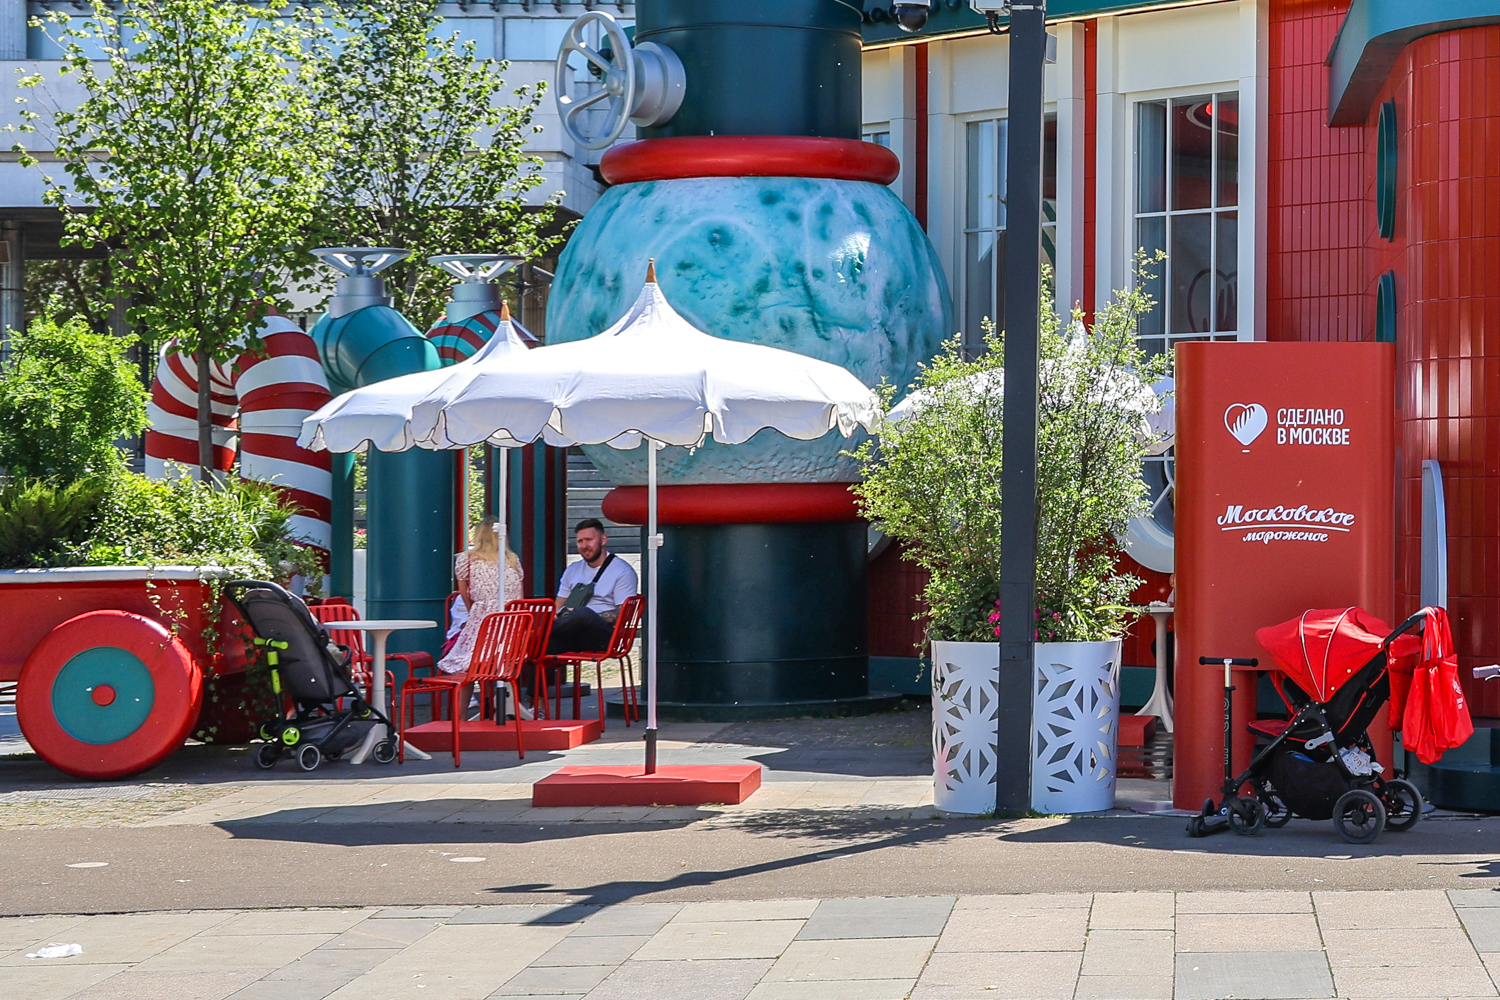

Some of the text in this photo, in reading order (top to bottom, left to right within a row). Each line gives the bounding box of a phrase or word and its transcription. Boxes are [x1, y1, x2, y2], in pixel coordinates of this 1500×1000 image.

[1277, 408, 1344, 427] СДЕЛАНО
[1277, 427, 1351, 445] В МОСКВЕ
[1217, 504, 1355, 526] Московское
[1242, 531, 1328, 545] мороженое
